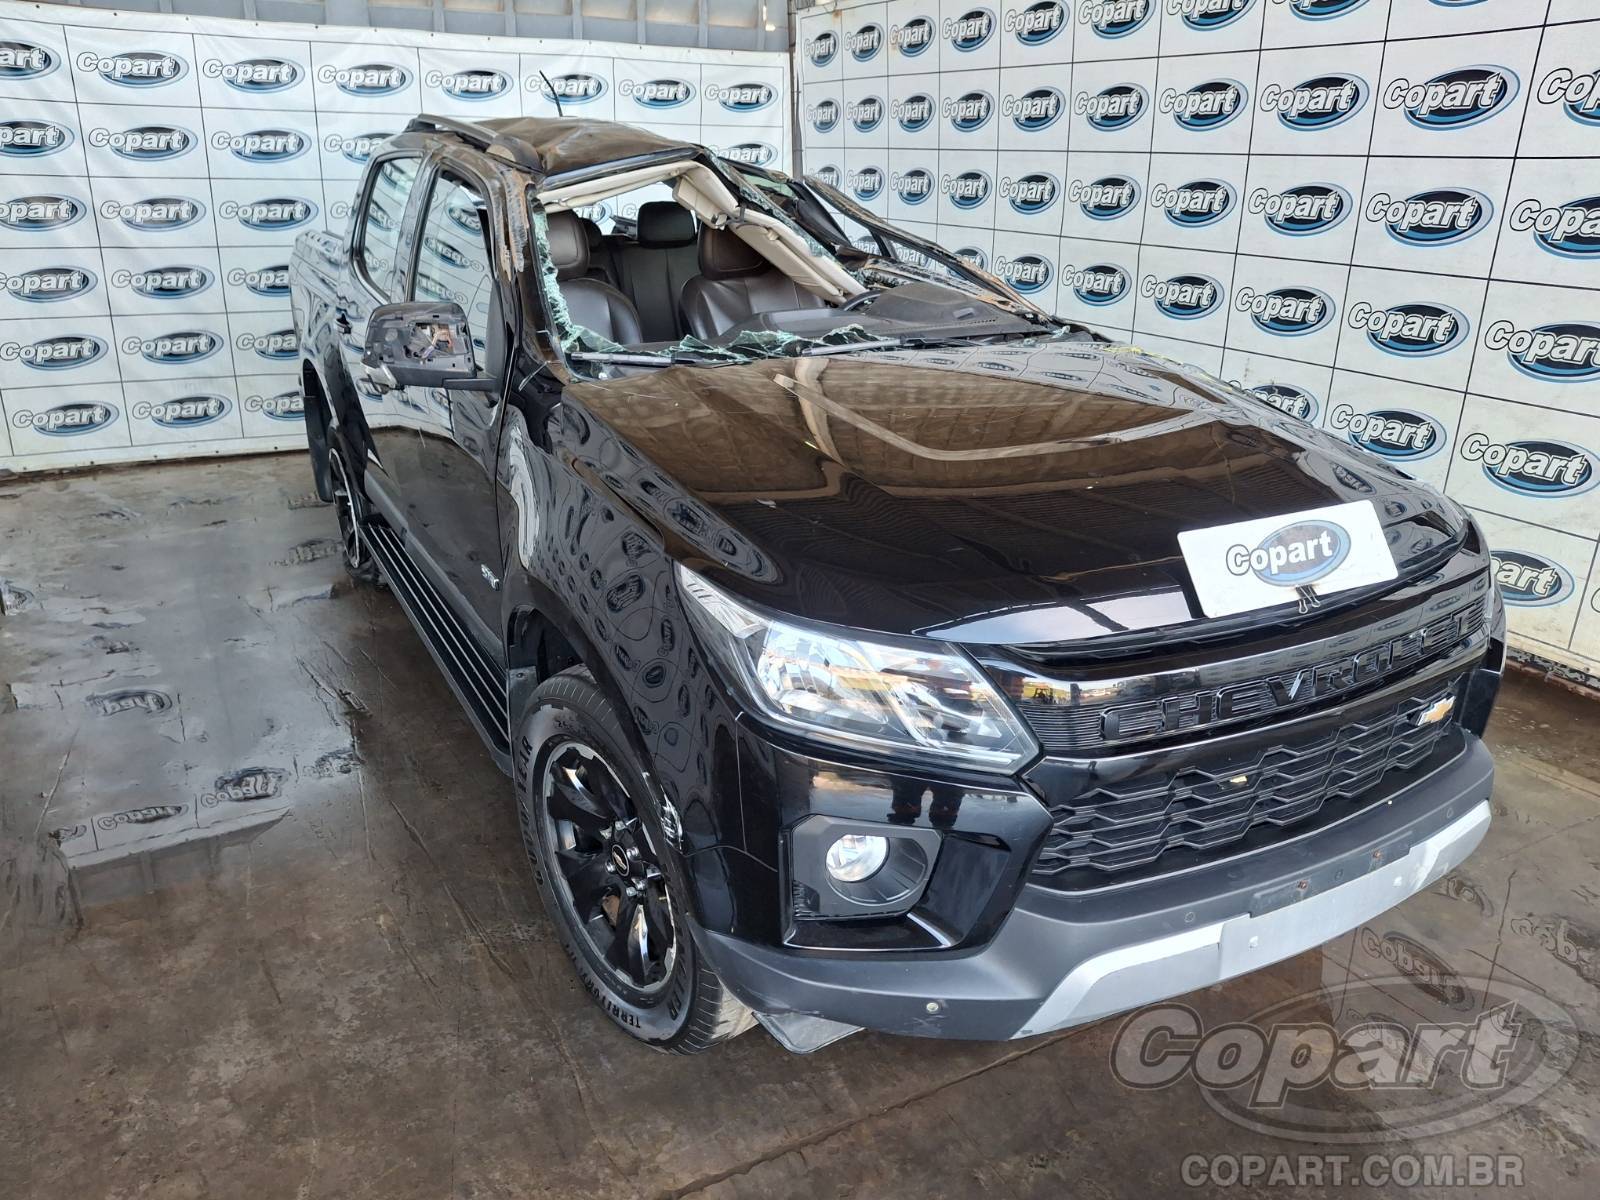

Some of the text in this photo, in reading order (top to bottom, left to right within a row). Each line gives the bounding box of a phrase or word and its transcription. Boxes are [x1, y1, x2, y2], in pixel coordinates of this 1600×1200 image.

[942, 12, 990, 44] Copart
[1003, 2, 1064, 37] Copart
[1078, 0, 1147, 29] Copart
[804, 36, 835, 58] Copart
[844, 30, 878, 56] Copart
[889, 22, 928, 49] Copart
[76, 51, 175, 79] Copart
[203, 58, 293, 85] Copart
[318, 64, 401, 88] Copart
[425, 69, 505, 95] Copart
[619, 79, 687, 103] Copart
[705, 83, 770, 105] Copart
[1383, 72, 1504, 117] Copart
[806, 101, 837, 126] Copart
[846, 99, 880, 126] Copart
[890, 96, 929, 124] Copart
[942, 93, 987, 124] Copart
[1002, 92, 1060, 123] Copart
[1074, 89, 1140, 120] Copart
[1159, 85, 1240, 121] Copart
[1260, 80, 1356, 121] Copart
[89, 127, 185, 153] Copart
[211, 130, 299, 155] Copart
[846, 170, 880, 193] Copart
[890, 171, 930, 194] Copart
[941, 173, 985, 200] Copart
[1000, 176, 1053, 206] Copart
[1068, 179, 1133, 209] Copart
[100, 200, 194, 223] Copart
[219, 200, 305, 222] Copart
[1150, 183, 1229, 217] Copart
[1248, 187, 1341, 223] Copart
[1365, 192, 1479, 232] Copart
[112, 268, 202, 292] Copart
[227, 268, 290, 289] Copa
[994, 256, 1048, 284] Copart
[1062, 264, 1125, 295] Copart
[1141, 274, 1216, 308] Copart
[1235, 286, 1325, 323] Copart
[1348, 301, 1456, 342] Copart
[0, 338, 94, 364] Copart
[122, 333, 210, 357] Copart
[236, 333, 298, 355] Copa
[132, 399, 220, 423] Copart
[245, 391, 304, 415] Copa
[12, 405, 104, 430] Copart
[1330, 404, 1435, 449] Copart
[1461, 432, 1587, 487] Copart
[1225, 530, 1333, 577] Copart
[1100, 606, 1476, 741] CHEVROLET
